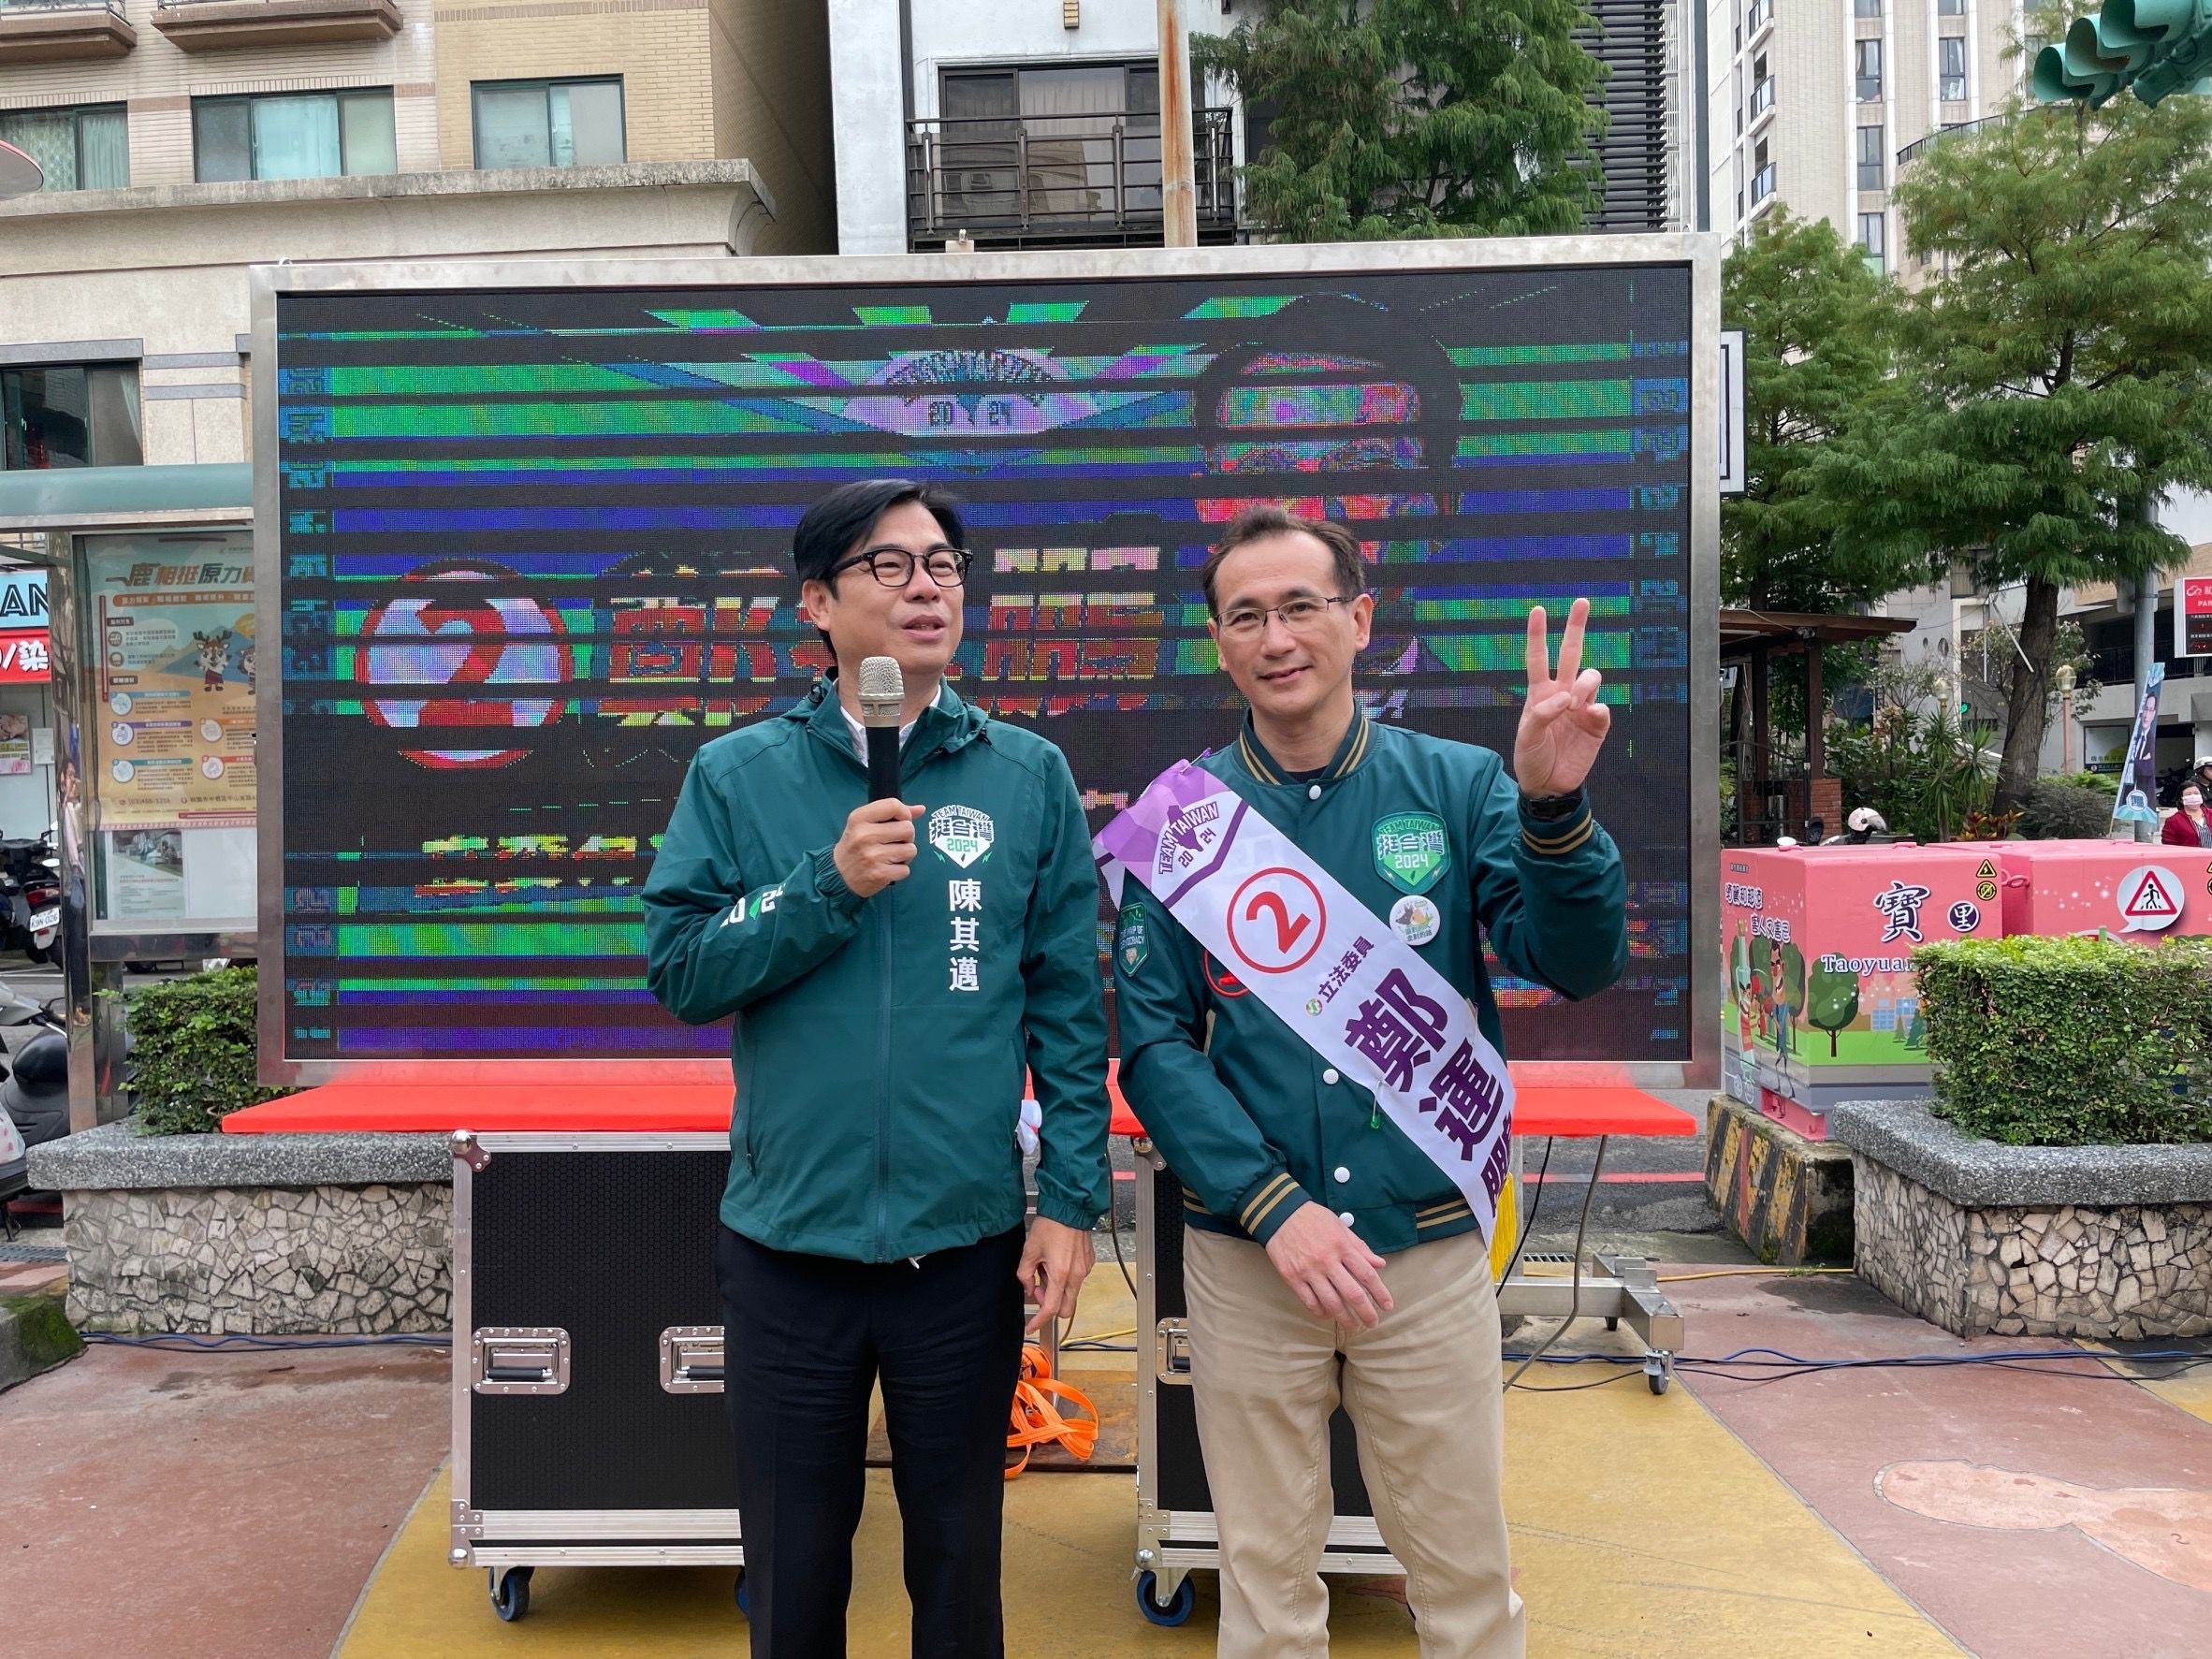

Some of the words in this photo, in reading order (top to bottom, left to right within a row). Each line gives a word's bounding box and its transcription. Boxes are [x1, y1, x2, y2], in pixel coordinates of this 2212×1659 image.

[0, 639, 48, 672] /染
[931, 805, 957, 819] TEAM
[957, 805, 990, 821] TAIWAN
[1377, 820, 1404, 834] TEAM
[1404, 818, 1442, 831] TAIWAN
[929, 818, 994, 844] 挺台灣
[947, 837, 978, 852] 2024
[1158, 830, 1179, 874] TEAM
[1169, 801, 1219, 836] TAIWAN
[1178, 851, 1194, 868] 20
[1200, 827, 1216, 844] 24
[1376, 829, 1445, 860] 挺台灣
[1394, 853, 1429, 869] 2024
[1245, 890, 1311, 954] 2
[1873, 880, 1930, 942] 寶
[1953, 904, 1974, 928] 里
[948, 878, 982, 993] 陳其邁
[1318, 936, 1375, 1003] 立法委員
